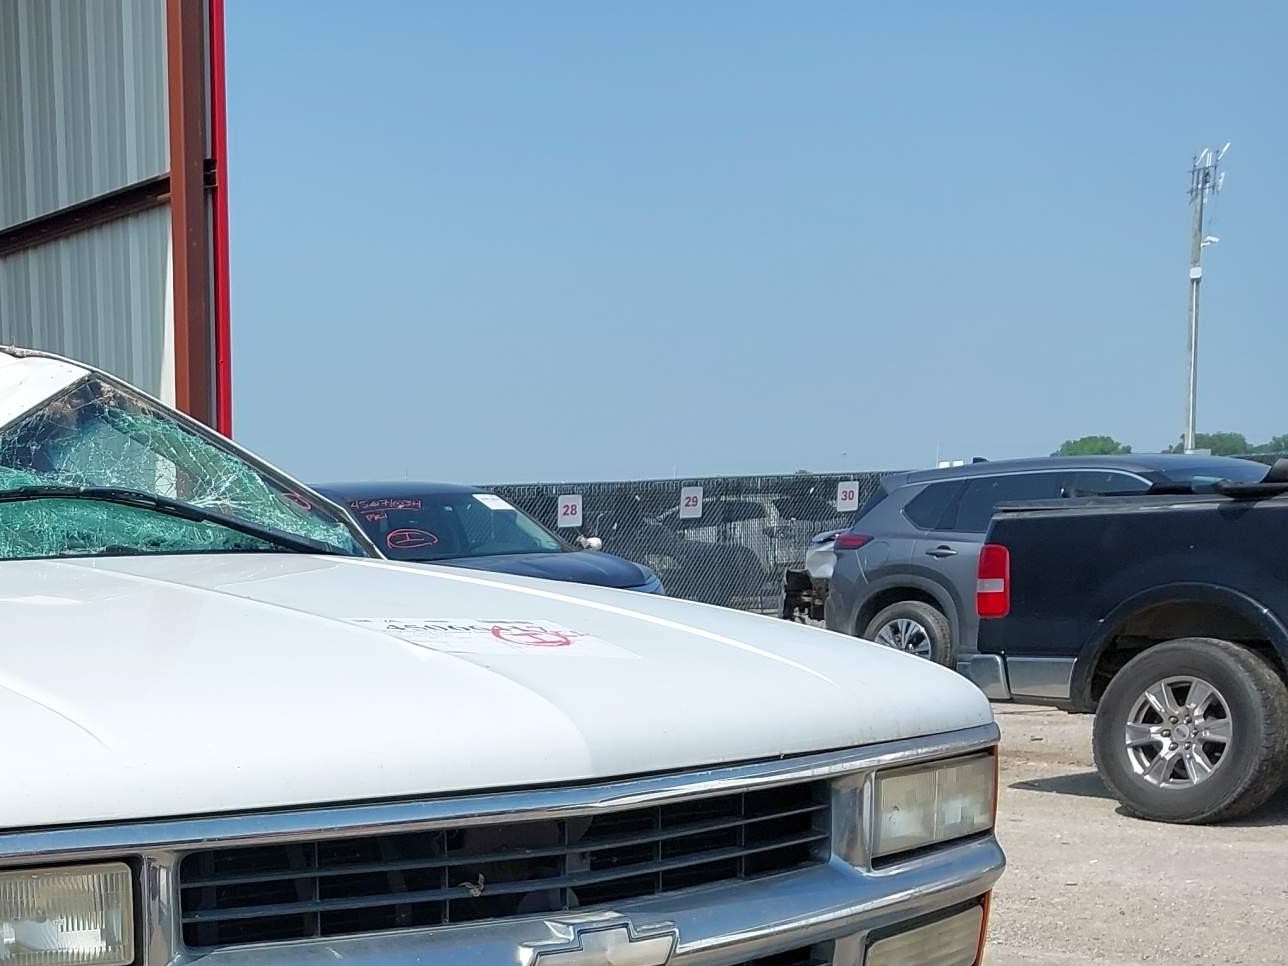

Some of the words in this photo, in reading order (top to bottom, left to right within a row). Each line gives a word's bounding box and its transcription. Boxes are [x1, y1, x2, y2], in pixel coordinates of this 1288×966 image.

[684, 495, 699, 507] 29
[840, 489, 855, 501] 30
[562, 503, 578, 516] 28
